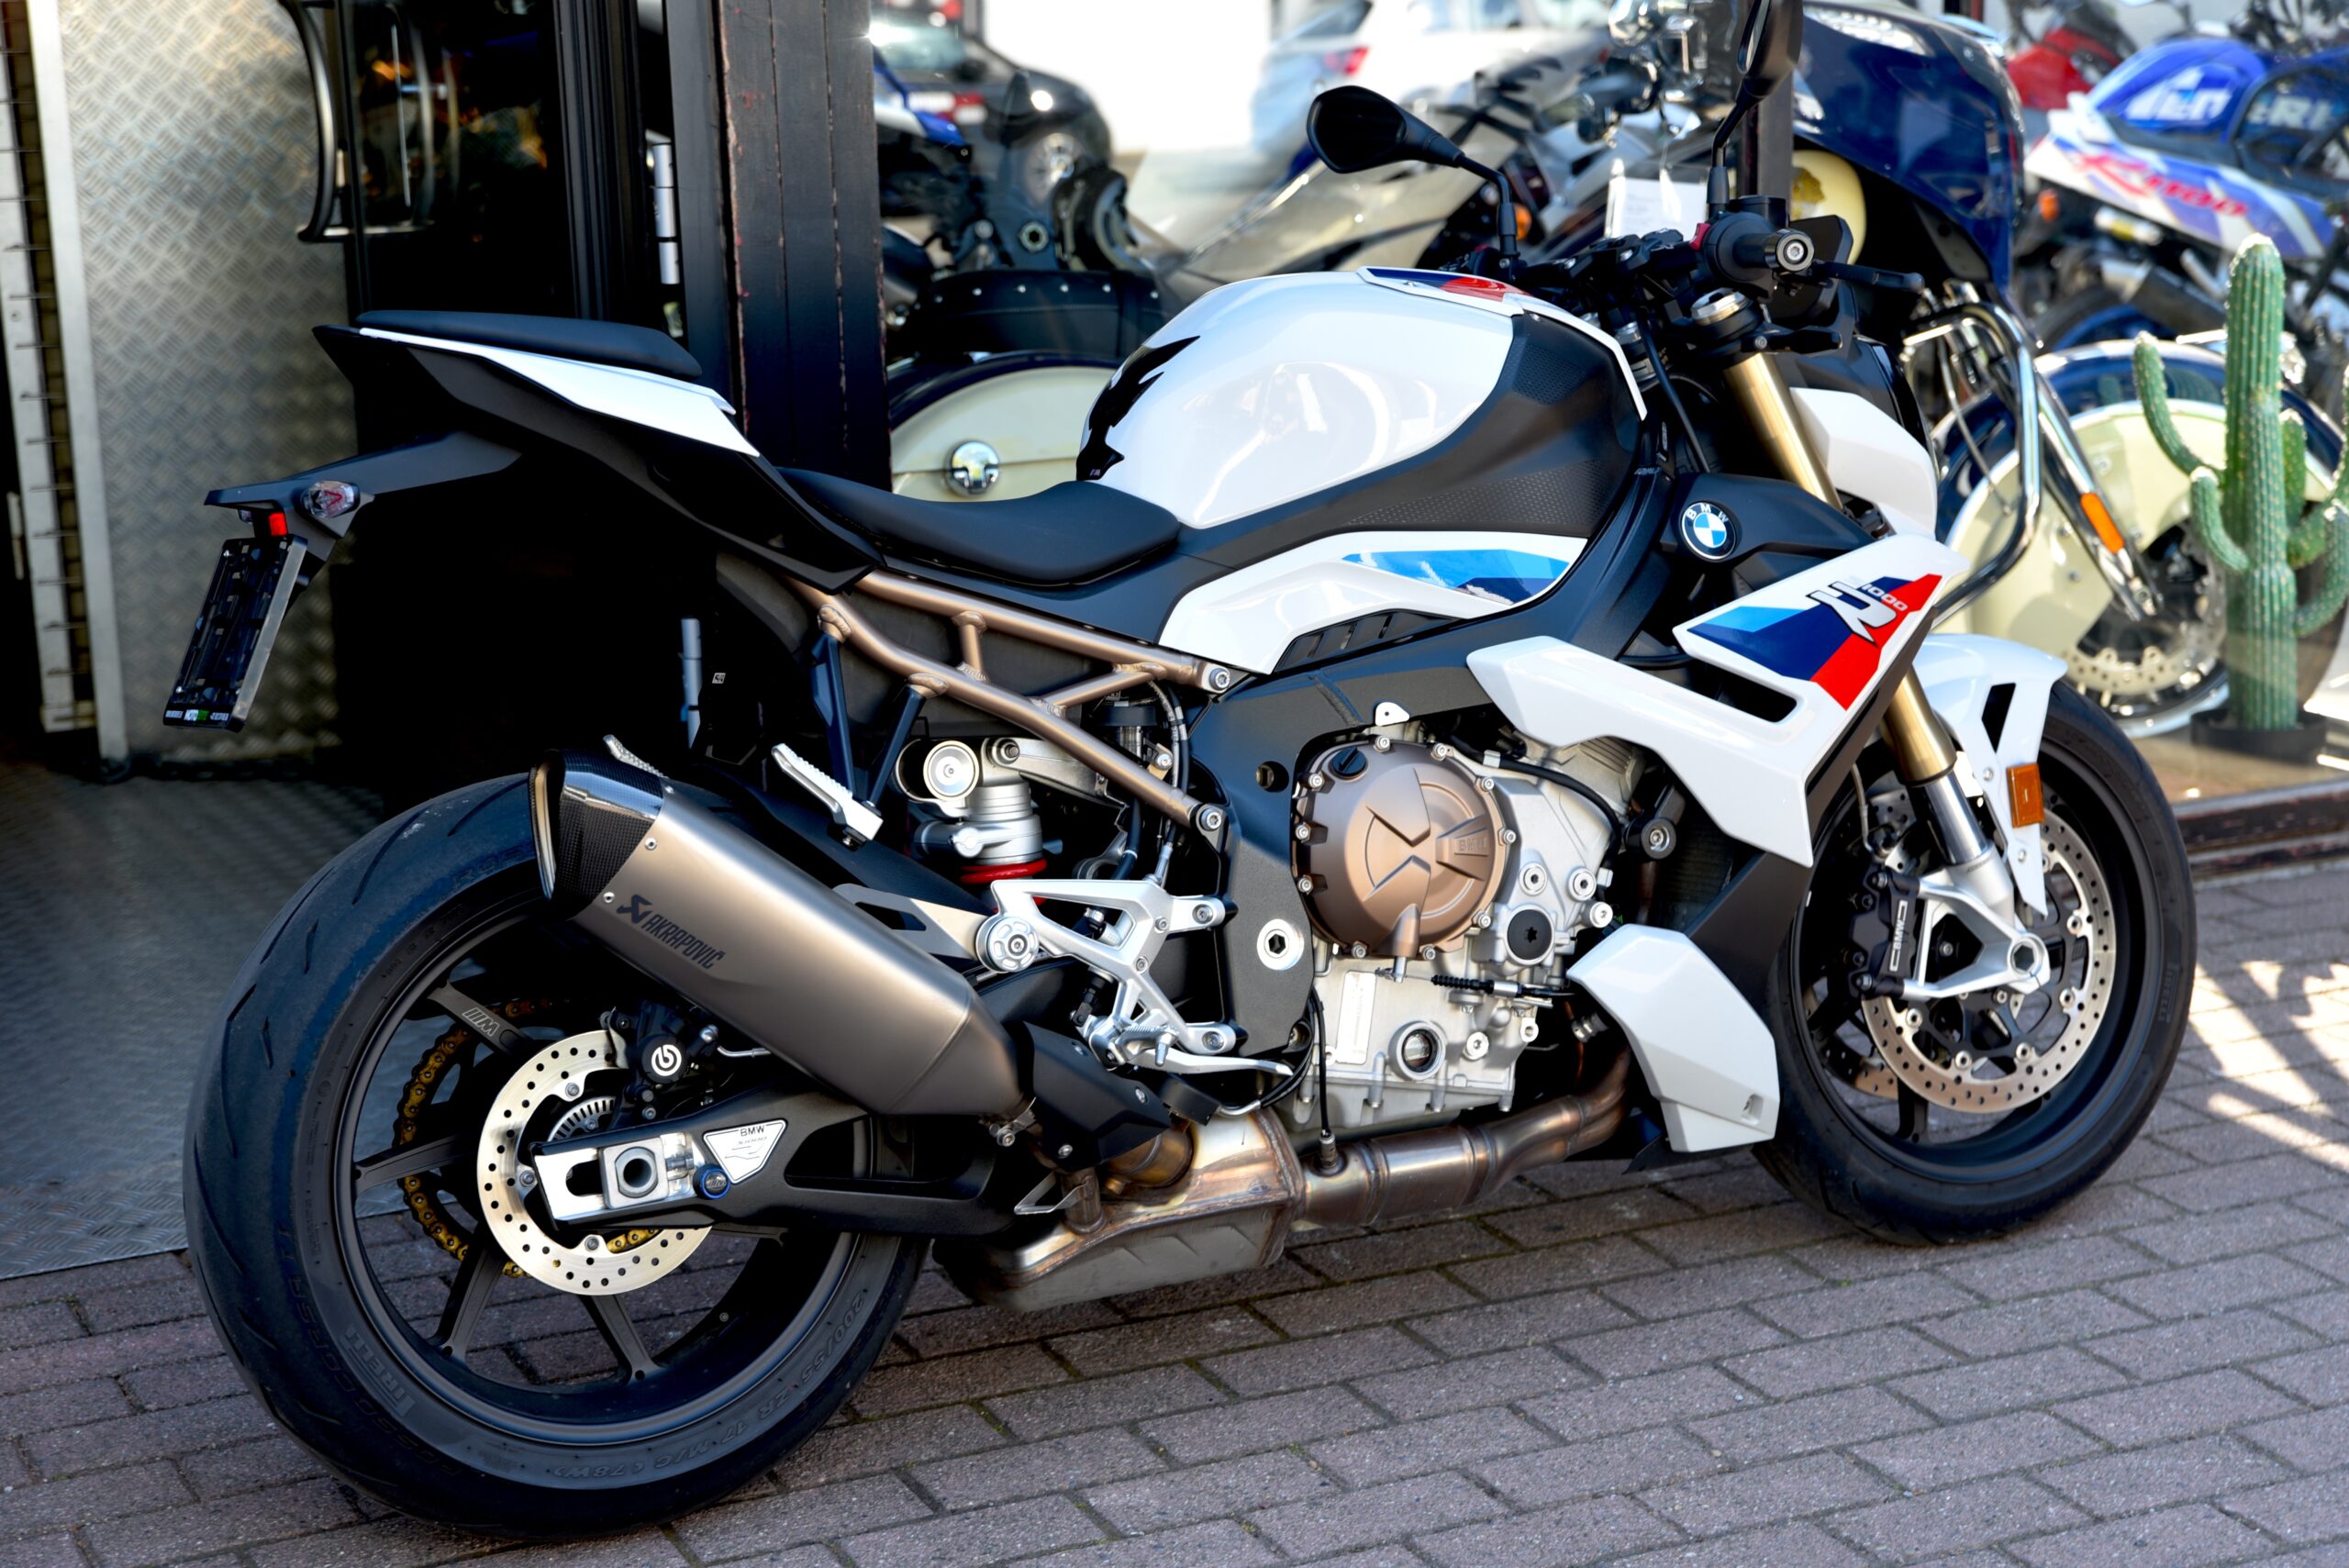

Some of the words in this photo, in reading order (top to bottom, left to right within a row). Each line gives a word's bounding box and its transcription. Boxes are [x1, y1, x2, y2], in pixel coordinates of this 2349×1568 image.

[1686, 503, 1729, 523] BMW
[1861, 584, 1909, 612] 1000
[640, 914, 726, 970] AKRAPOVIČ
[1893, 919, 1905, 951] BMW
[740, 1126, 765, 1137] BMW
[801, 1291, 865, 1385] 200/55
[342, 1328, 416, 1418] PIRELLI
[654, 1441, 710, 1470] M/C
